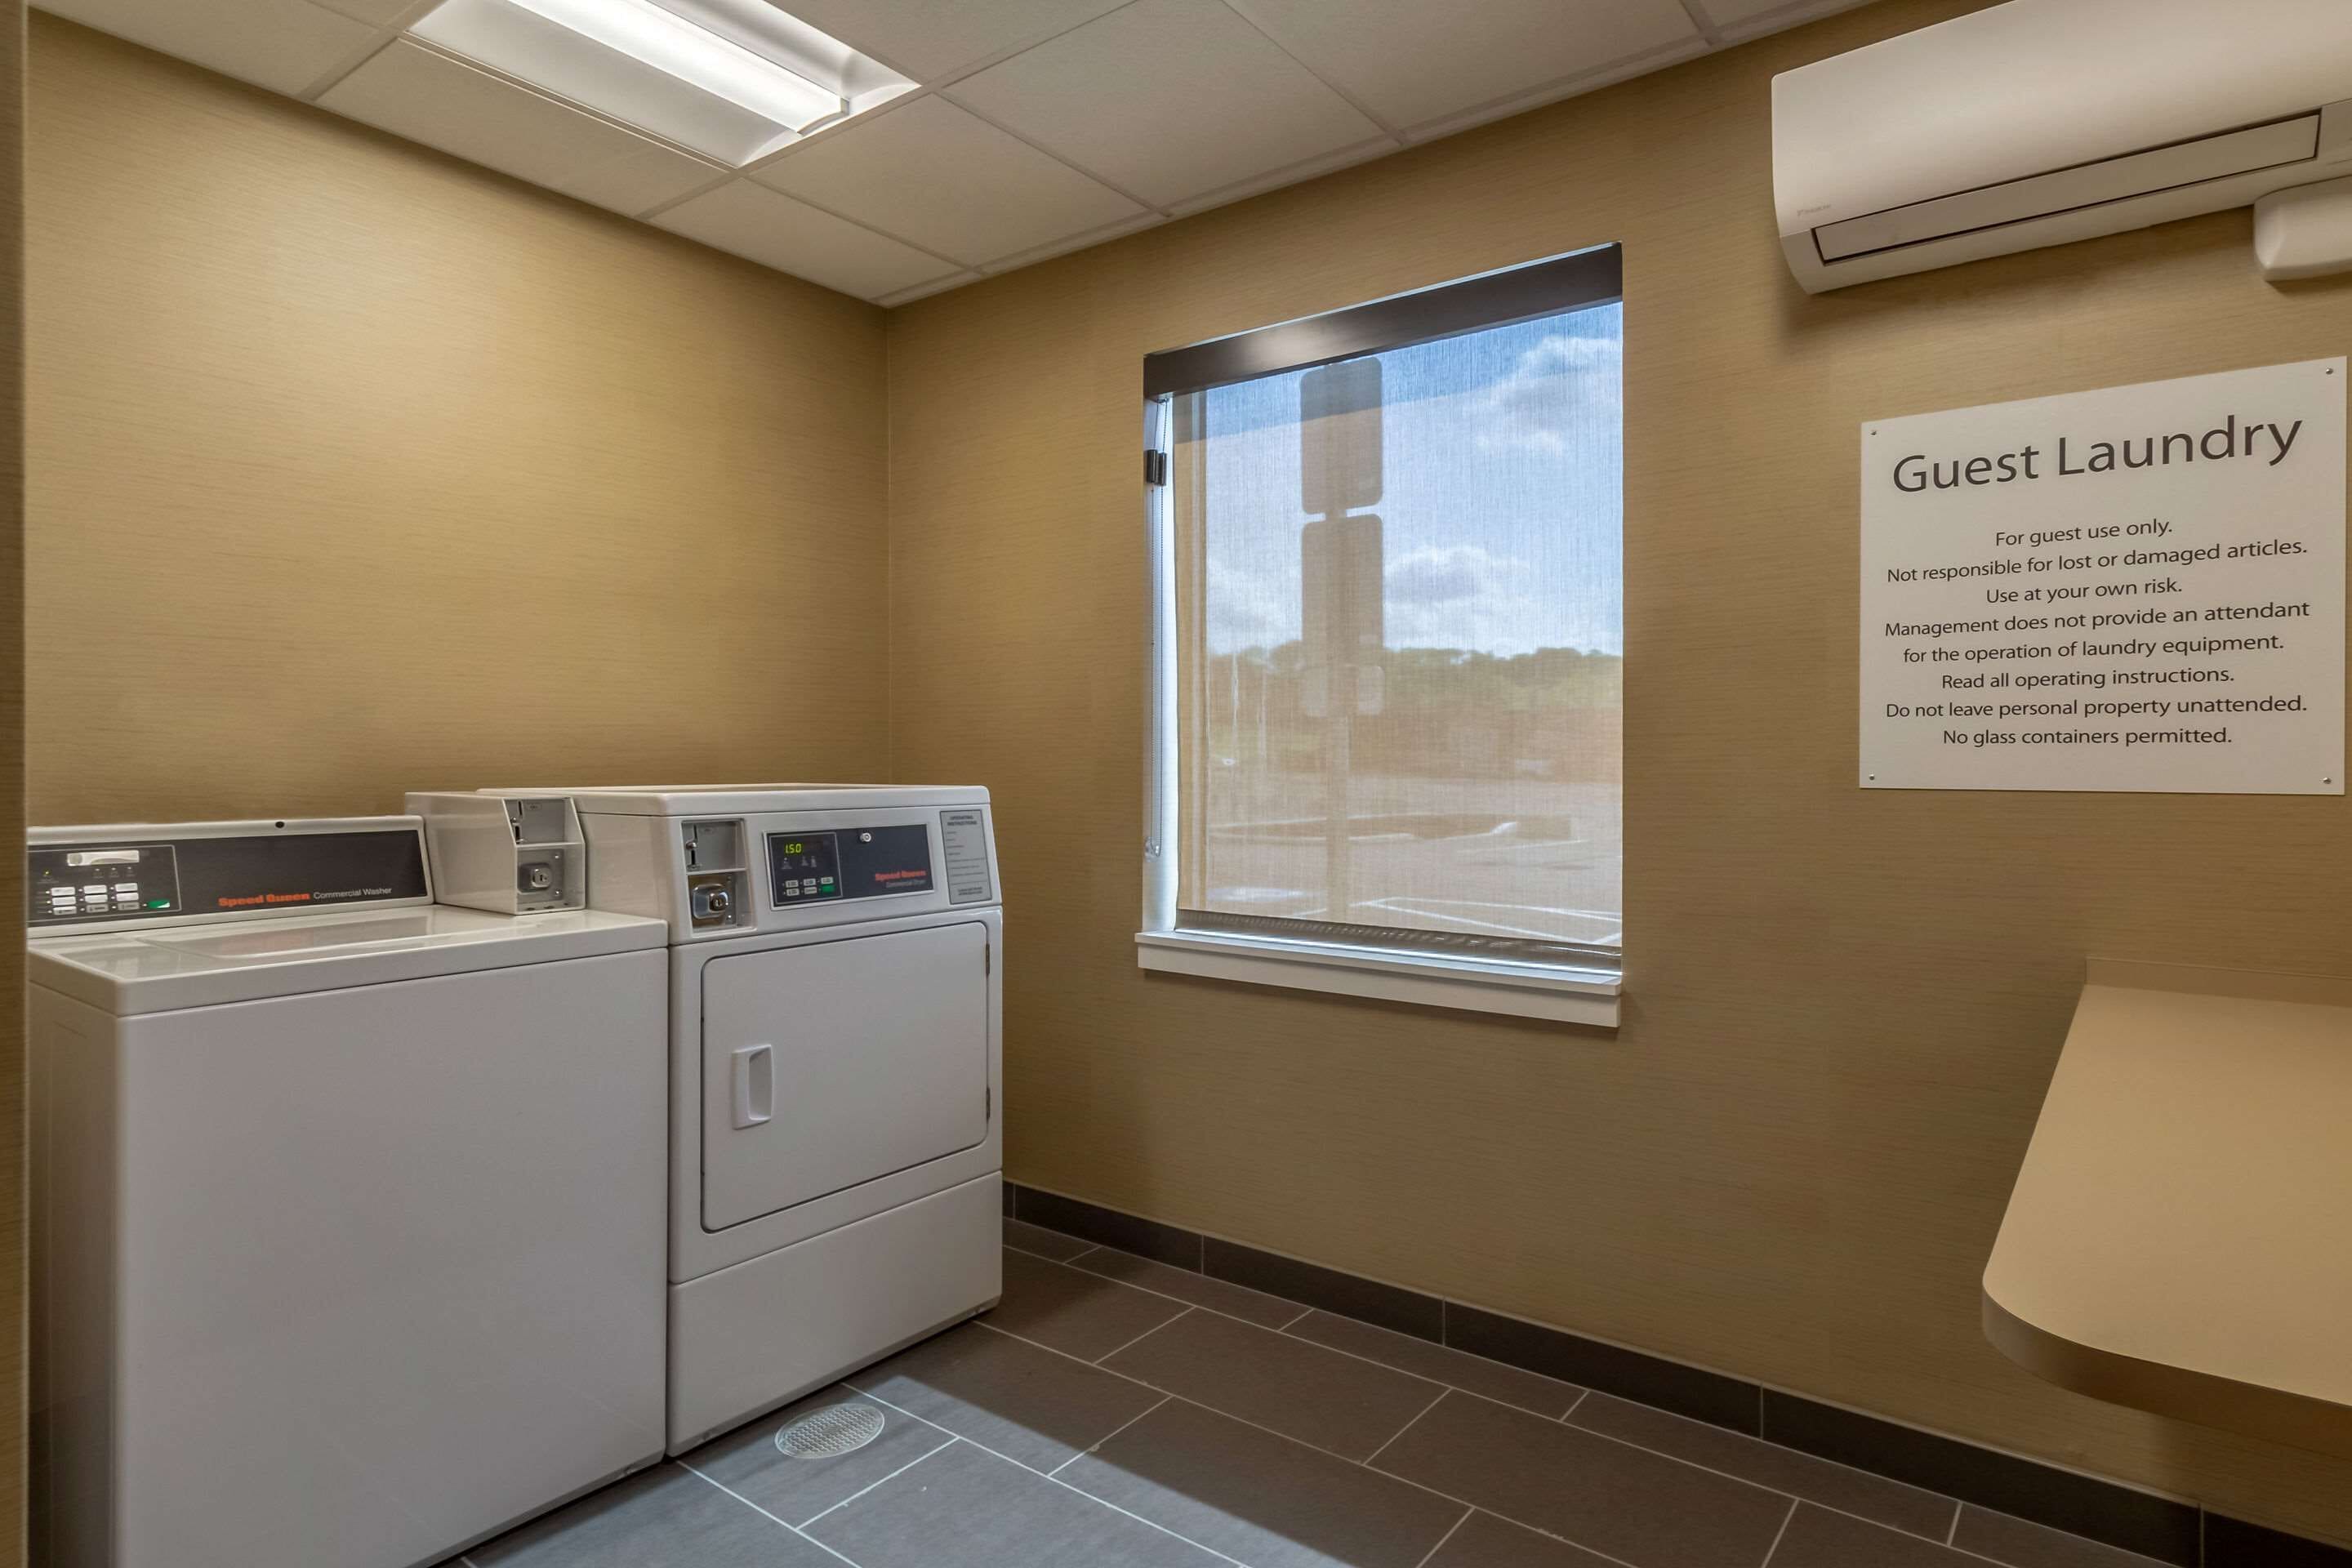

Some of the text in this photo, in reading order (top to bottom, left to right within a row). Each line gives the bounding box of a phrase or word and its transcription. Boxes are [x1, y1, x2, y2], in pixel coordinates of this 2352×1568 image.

[1893, 414, 2304, 493] Guest Laundry
[1995, 518, 2173, 548] For guest use only.
[1887, 538, 2308, 583] Not responsible for lost or damaged articles.
[1986, 577, 2183, 604] Use at your own risk.
[1885, 601, 2311, 639] Management does not provide an attendant
[1902, 635, 2284, 664] for the operation of laundry equipment.
[1942, 666, 2235, 691] Read all operating instructions.
[1886, 694, 2307, 719] Do not leave personal property unattended.
[1943, 726, 2233, 748] No glass containers permitted.
[218, 896, 264, 907] Speed
[313, 889, 362, 900] Commercial
[362, 887, 393, 896] Washer
